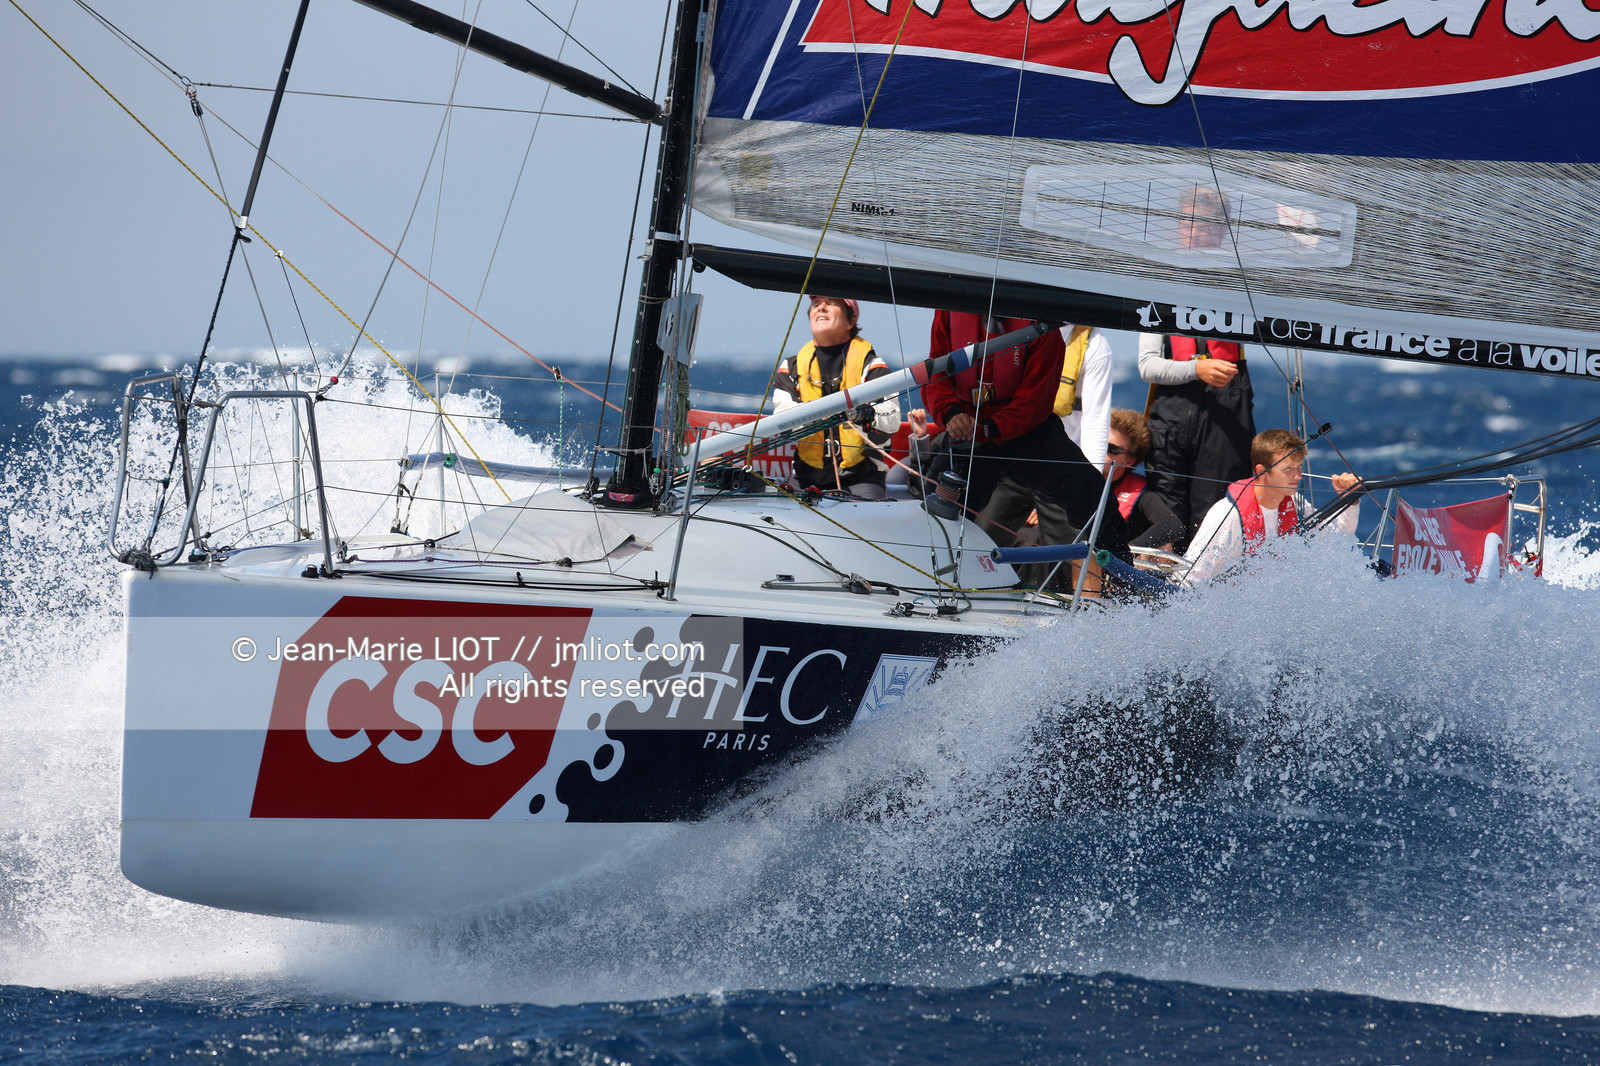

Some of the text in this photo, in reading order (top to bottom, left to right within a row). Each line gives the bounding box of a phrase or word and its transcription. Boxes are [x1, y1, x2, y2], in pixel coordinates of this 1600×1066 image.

[1172, 305, 1265, 334] tour
[1271, 318, 1313, 341] de
[1320, 323, 1450, 358] france
[1488, 340, 1512, 366] la
[305, 654, 535, 766] CSC
[659, 641, 847, 725] HEC
[703, 732, 771, 751] PARIS
